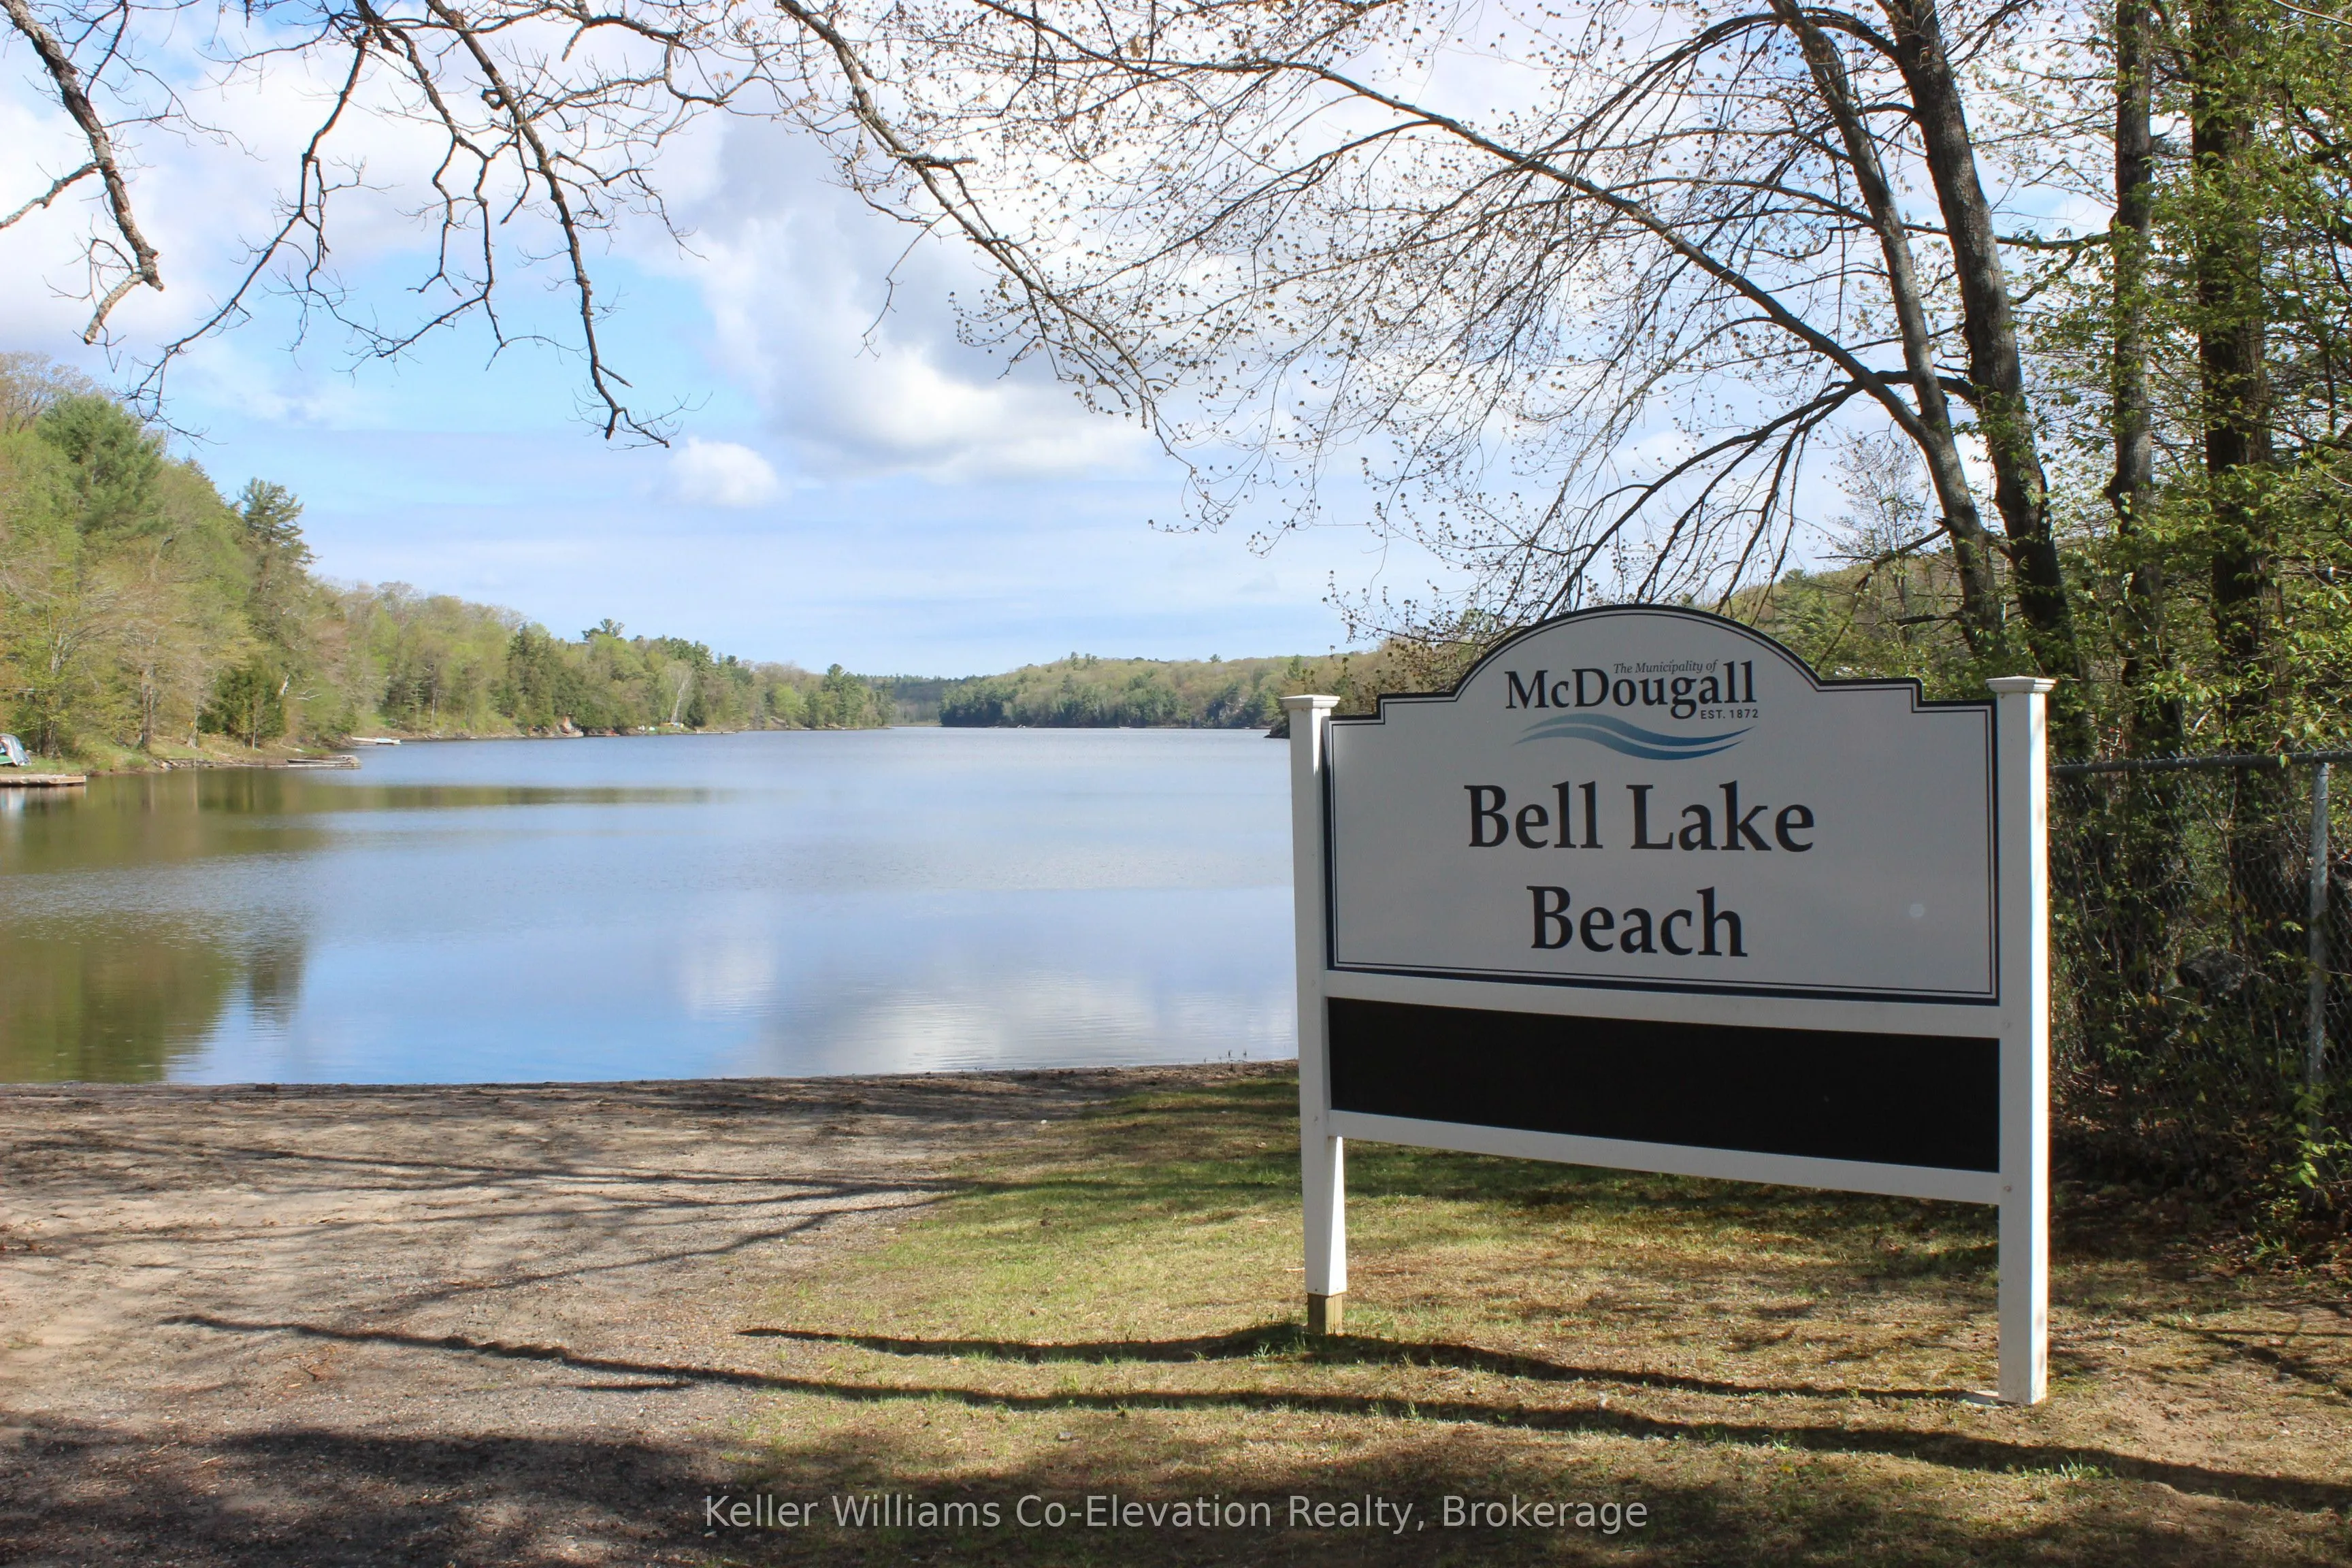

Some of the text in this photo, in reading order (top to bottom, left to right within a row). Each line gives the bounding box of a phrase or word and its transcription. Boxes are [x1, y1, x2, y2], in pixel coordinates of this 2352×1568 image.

[1504, 660, 1757, 719] McDougall
[1613, 659, 1719, 675] The Municipality of
[1701, 709, 1759, 719] EST. 1872
[1464, 780, 1814, 852] Bell Lake
[1526, 886, 1748, 957] Beach
